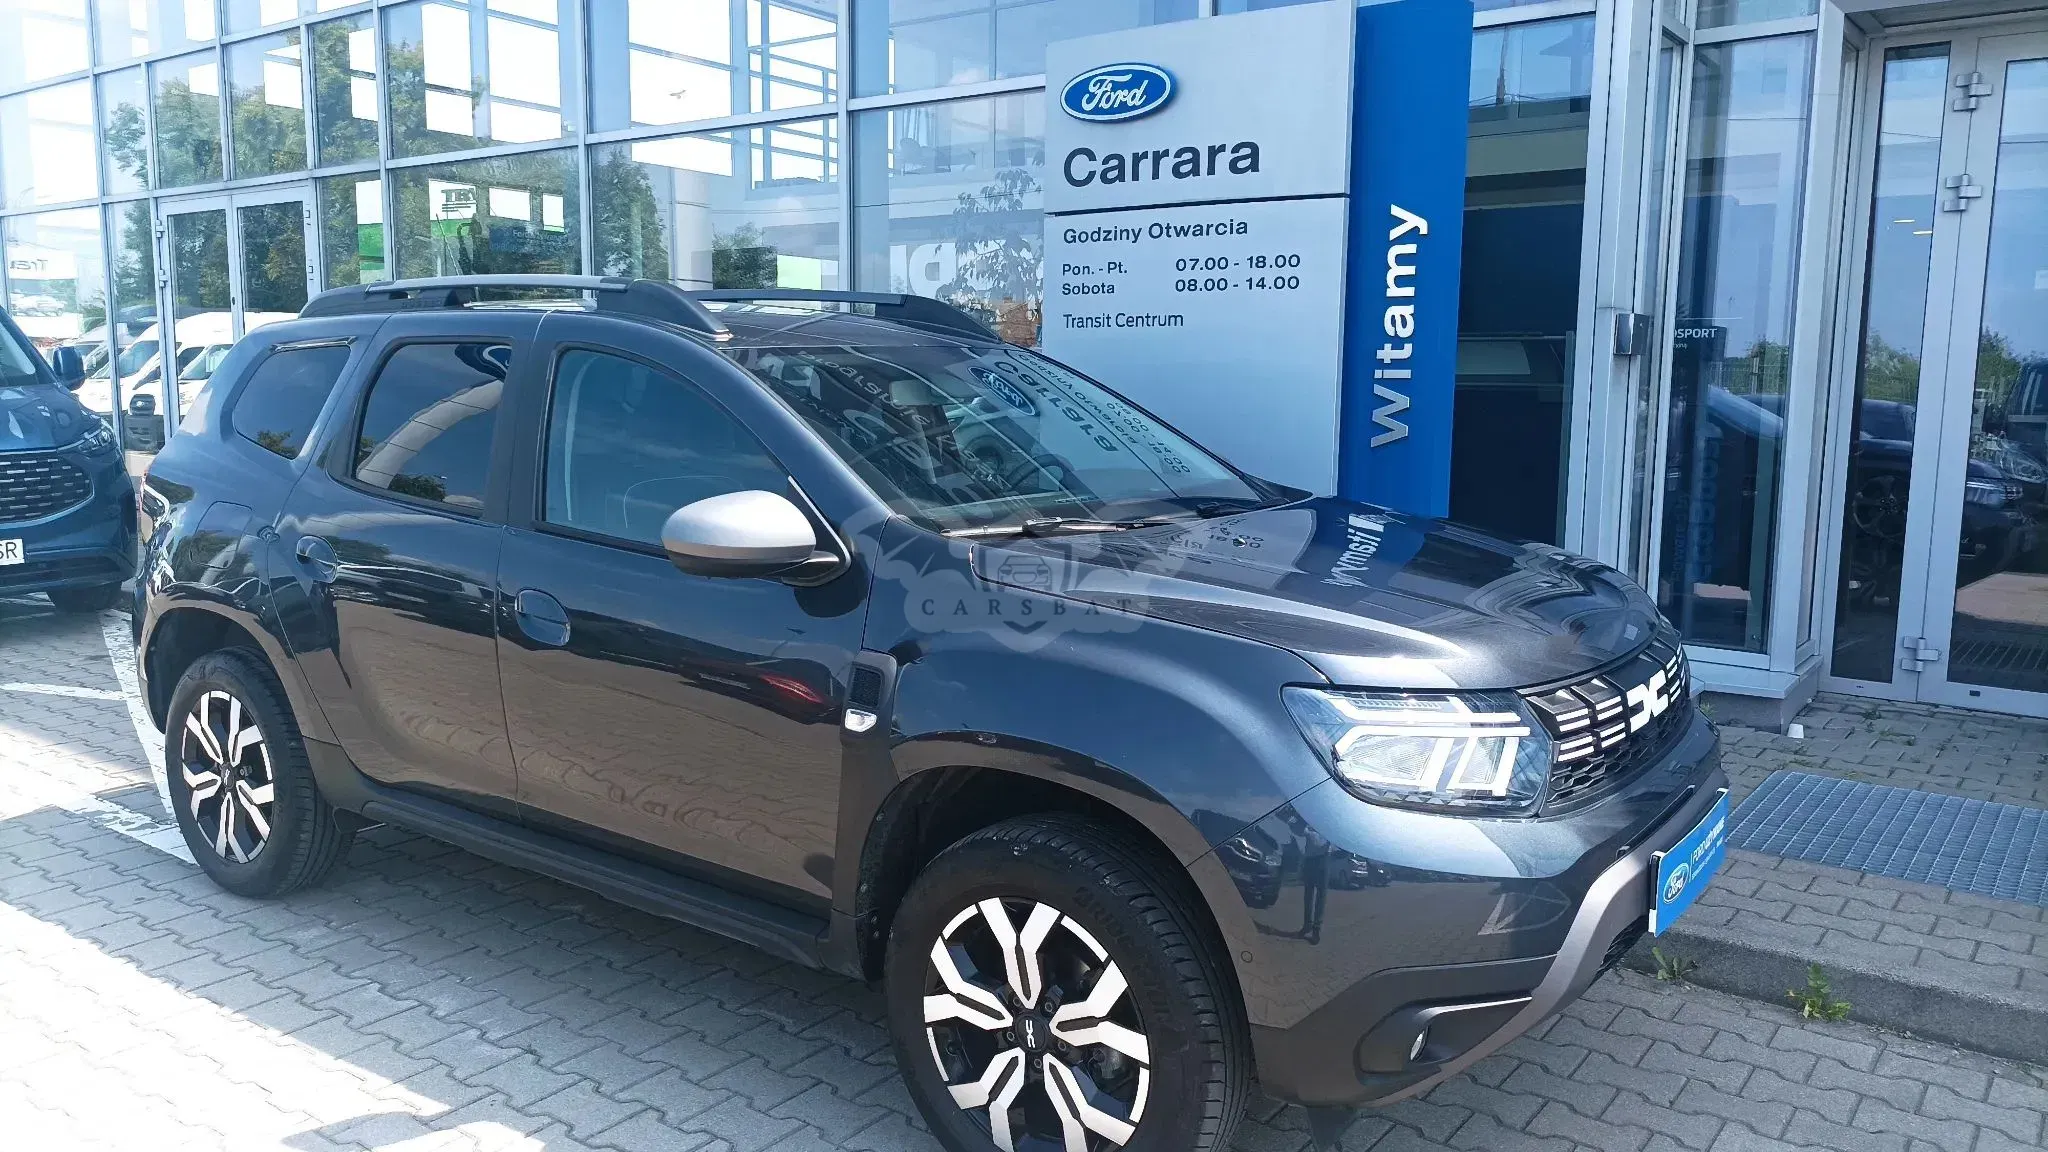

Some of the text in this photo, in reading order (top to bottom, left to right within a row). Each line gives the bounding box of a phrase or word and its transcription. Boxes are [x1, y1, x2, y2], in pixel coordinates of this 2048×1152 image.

[1081, 73, 1146, 112] Ford
[1063, 140, 1261, 188] Carrara
[1063, 219, 1249, 245] Godziny Otwarcia
[1062, 263, 1095, 277] Pon.
[1107, 261, 1128, 274] Pt.
[1175, 256, 1229, 272] 07.00
[1246, 254, 1301, 270] 18.00
[1062, 281, 1115, 296] Sobota
[1175, 277, 1228, 293] 08.00
[1245, 275, 1300, 291] 14.00
[1063, 312, 1184, 329] Transit Centrum
[1370, 203, 1429, 448] Witamy
